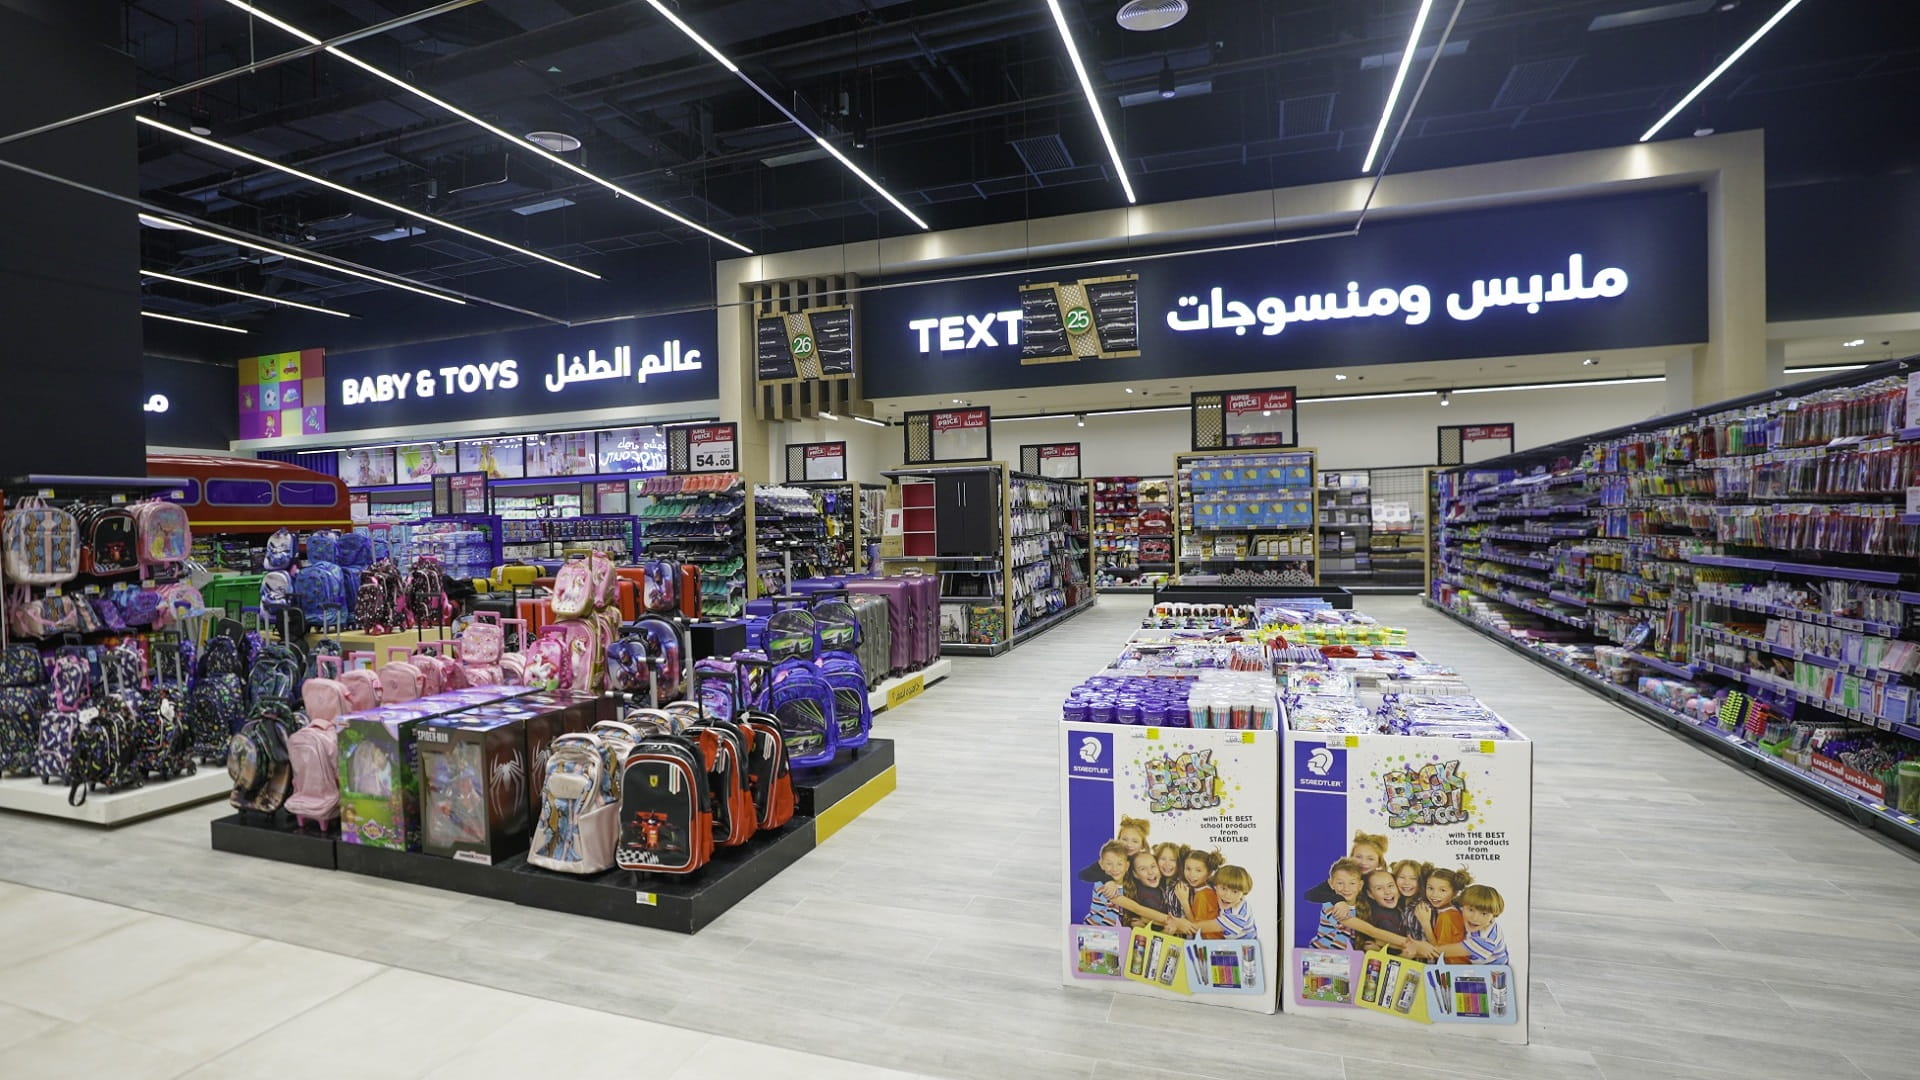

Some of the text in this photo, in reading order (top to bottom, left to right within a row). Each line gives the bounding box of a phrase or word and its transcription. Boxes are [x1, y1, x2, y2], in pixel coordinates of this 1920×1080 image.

[1167, 254, 1629, 335] ملابس ومنسوجات
[1068, 311, 1089, 328] 25
[908, 310, 1023, 353] TEXT
[794, 337, 811, 353] 26
[545, 340, 702, 393] عالم الطفل
[343, 360, 518, 405] BABY & TOYS
[1232, 400, 1258, 409] PRICE
[938, 418, 959, 426] PRICE
[1073, 765, 1110, 775] STAEDTLER
[1300, 778, 1343, 787] STAEDTLER
[1225, 822, 1257, 830] products
[1449, 831, 1505, 839] with THE BEST
[1473, 839, 1510, 848] products
[1455, 853, 1501, 861] STAEDTLER
